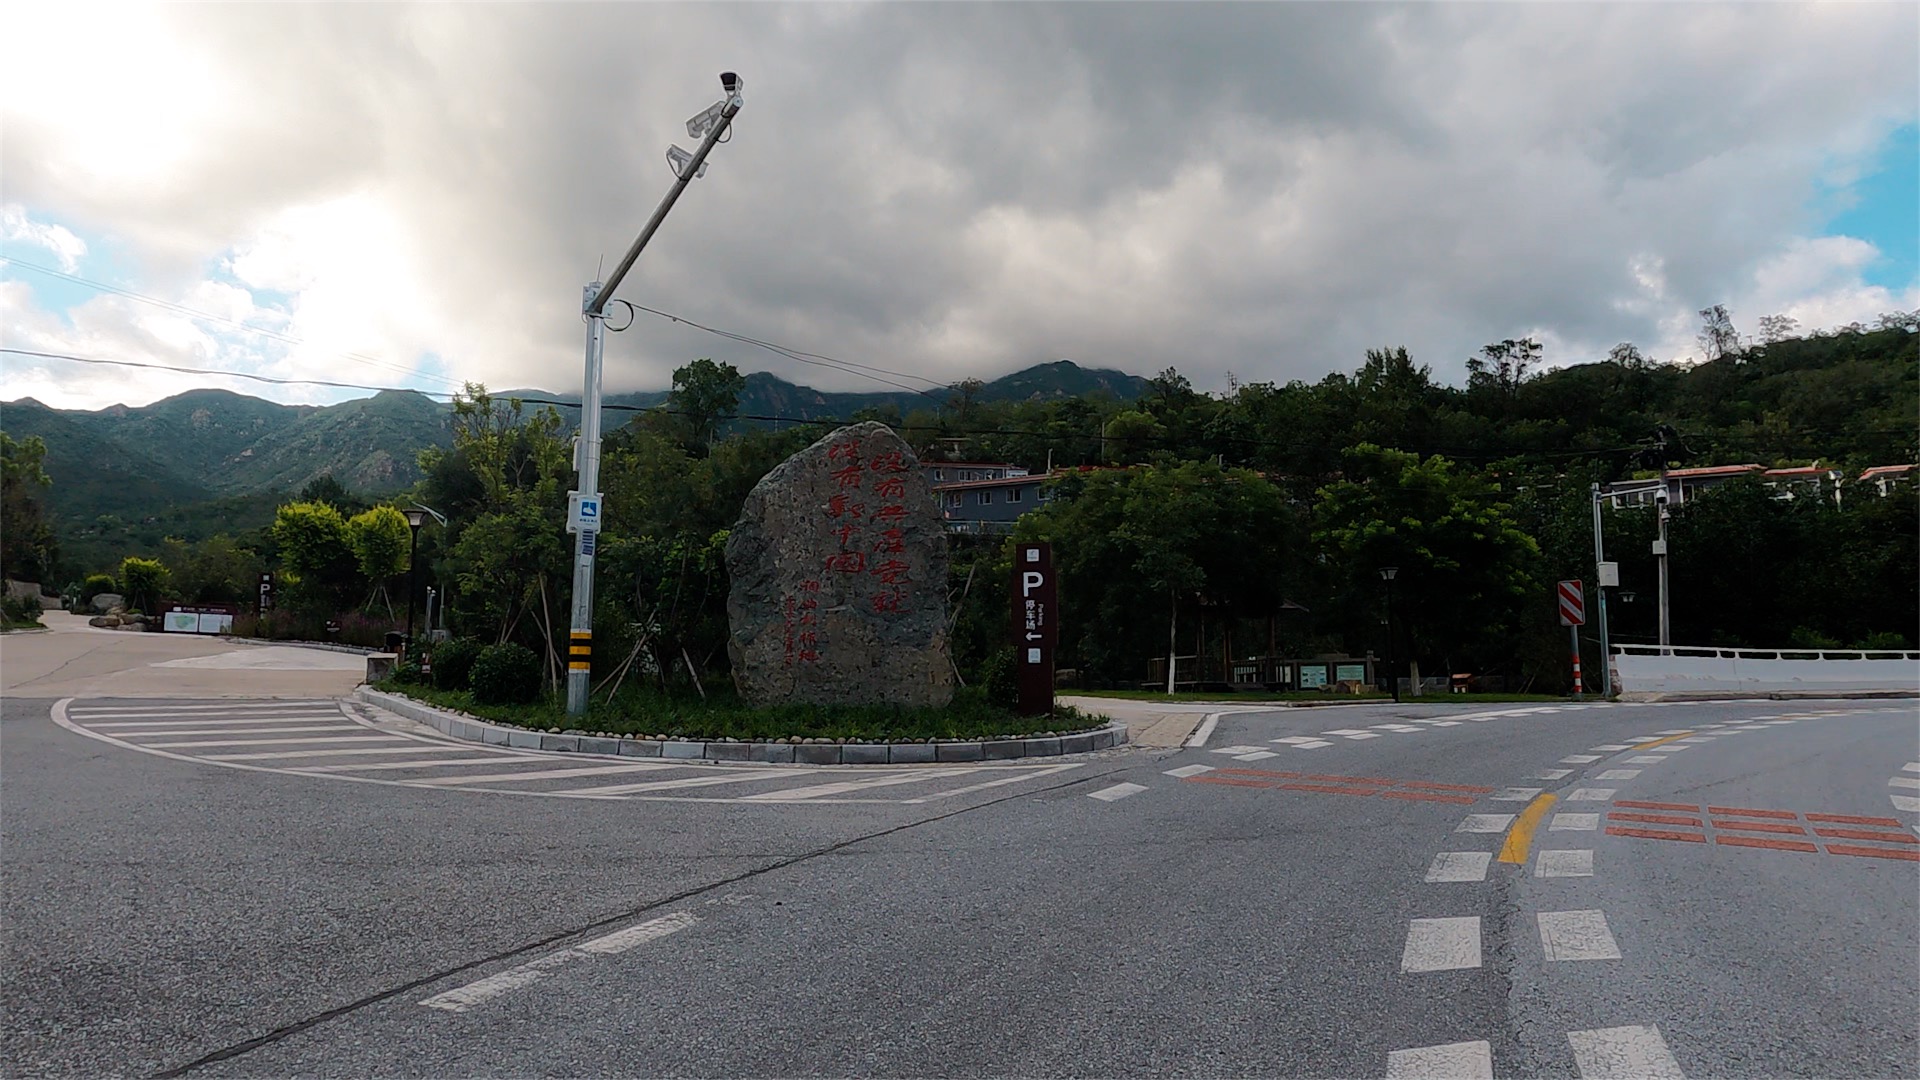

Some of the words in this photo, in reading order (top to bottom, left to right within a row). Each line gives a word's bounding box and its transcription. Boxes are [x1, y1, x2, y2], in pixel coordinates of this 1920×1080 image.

[260, 583, 271, 595] P
[1023, 571, 1044, 598] P
[1025, 599, 1036, 631] 停车场
